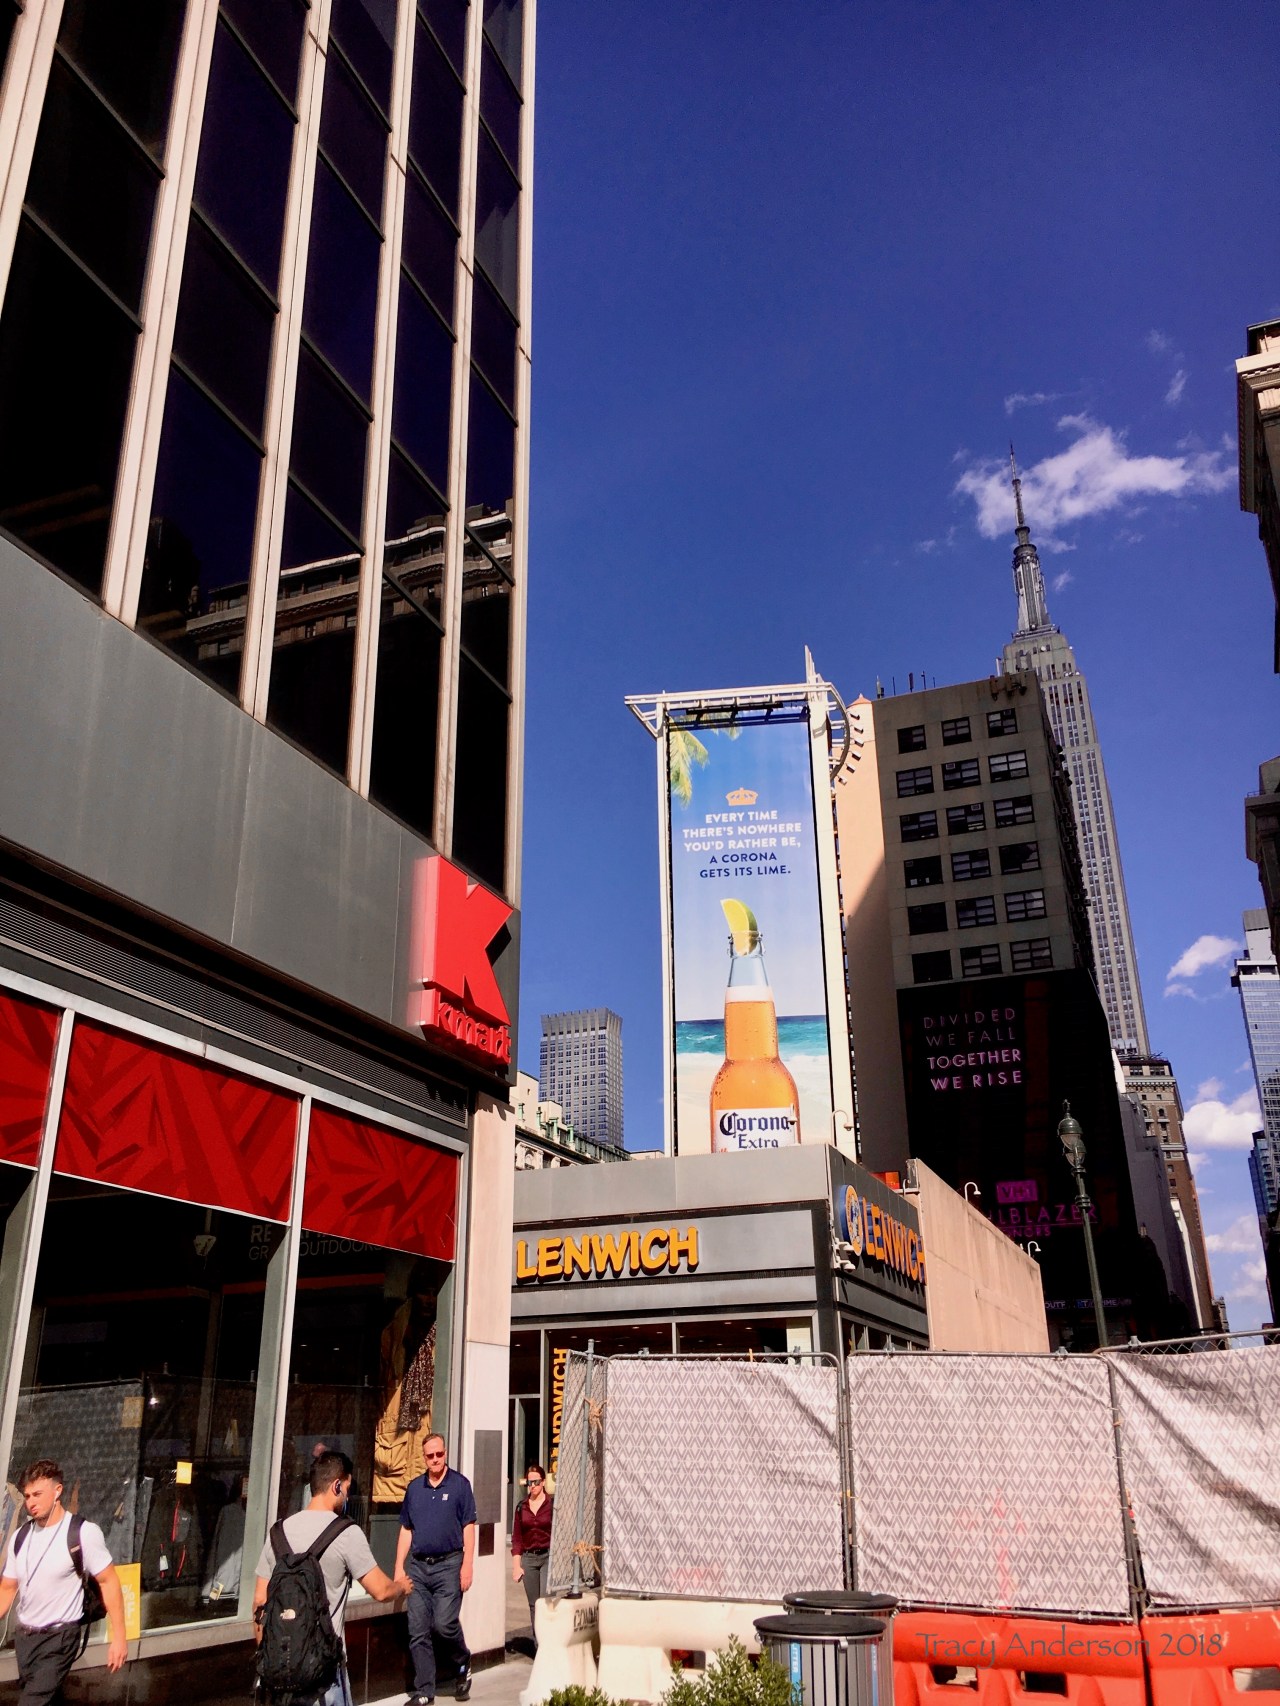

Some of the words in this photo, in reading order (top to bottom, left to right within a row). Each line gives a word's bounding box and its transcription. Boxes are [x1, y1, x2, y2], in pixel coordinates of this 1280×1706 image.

[705, 812, 743, 824] EVERY
[748, 810, 778, 821] TIME
[683, 825, 733, 838] THERE'S
[738, 822, 802, 836] NOWHERE
[684, 841, 724, 852] YOU'D
[728, 838, 777, 850] RATHER
[781, 837, 801, 848] BE,
[709, 855, 718, 864] A
[722, 851, 777, 863] CORONA
[700, 868, 730, 878] GETS
[734, 866, 753, 877] ITS
[757, 865, 791, 876] LIME.
[923, 1007, 1016, 1029] DIVIDED
[926, 1032, 957, 1047] WE
[968, 1026, 1016, 1044] FALL
[927, 1048, 1021, 1070] TOGETHER
[930, 1075, 962, 1092] WE
[973, 1070, 1022, 1088] RISE
[719, 1112, 790, 1138] Corona
[738, 1133, 779, 1148] Extra
[861, 1196, 927, 1287] LENWICH
[516, 1226, 698, 1281] LENWICH
